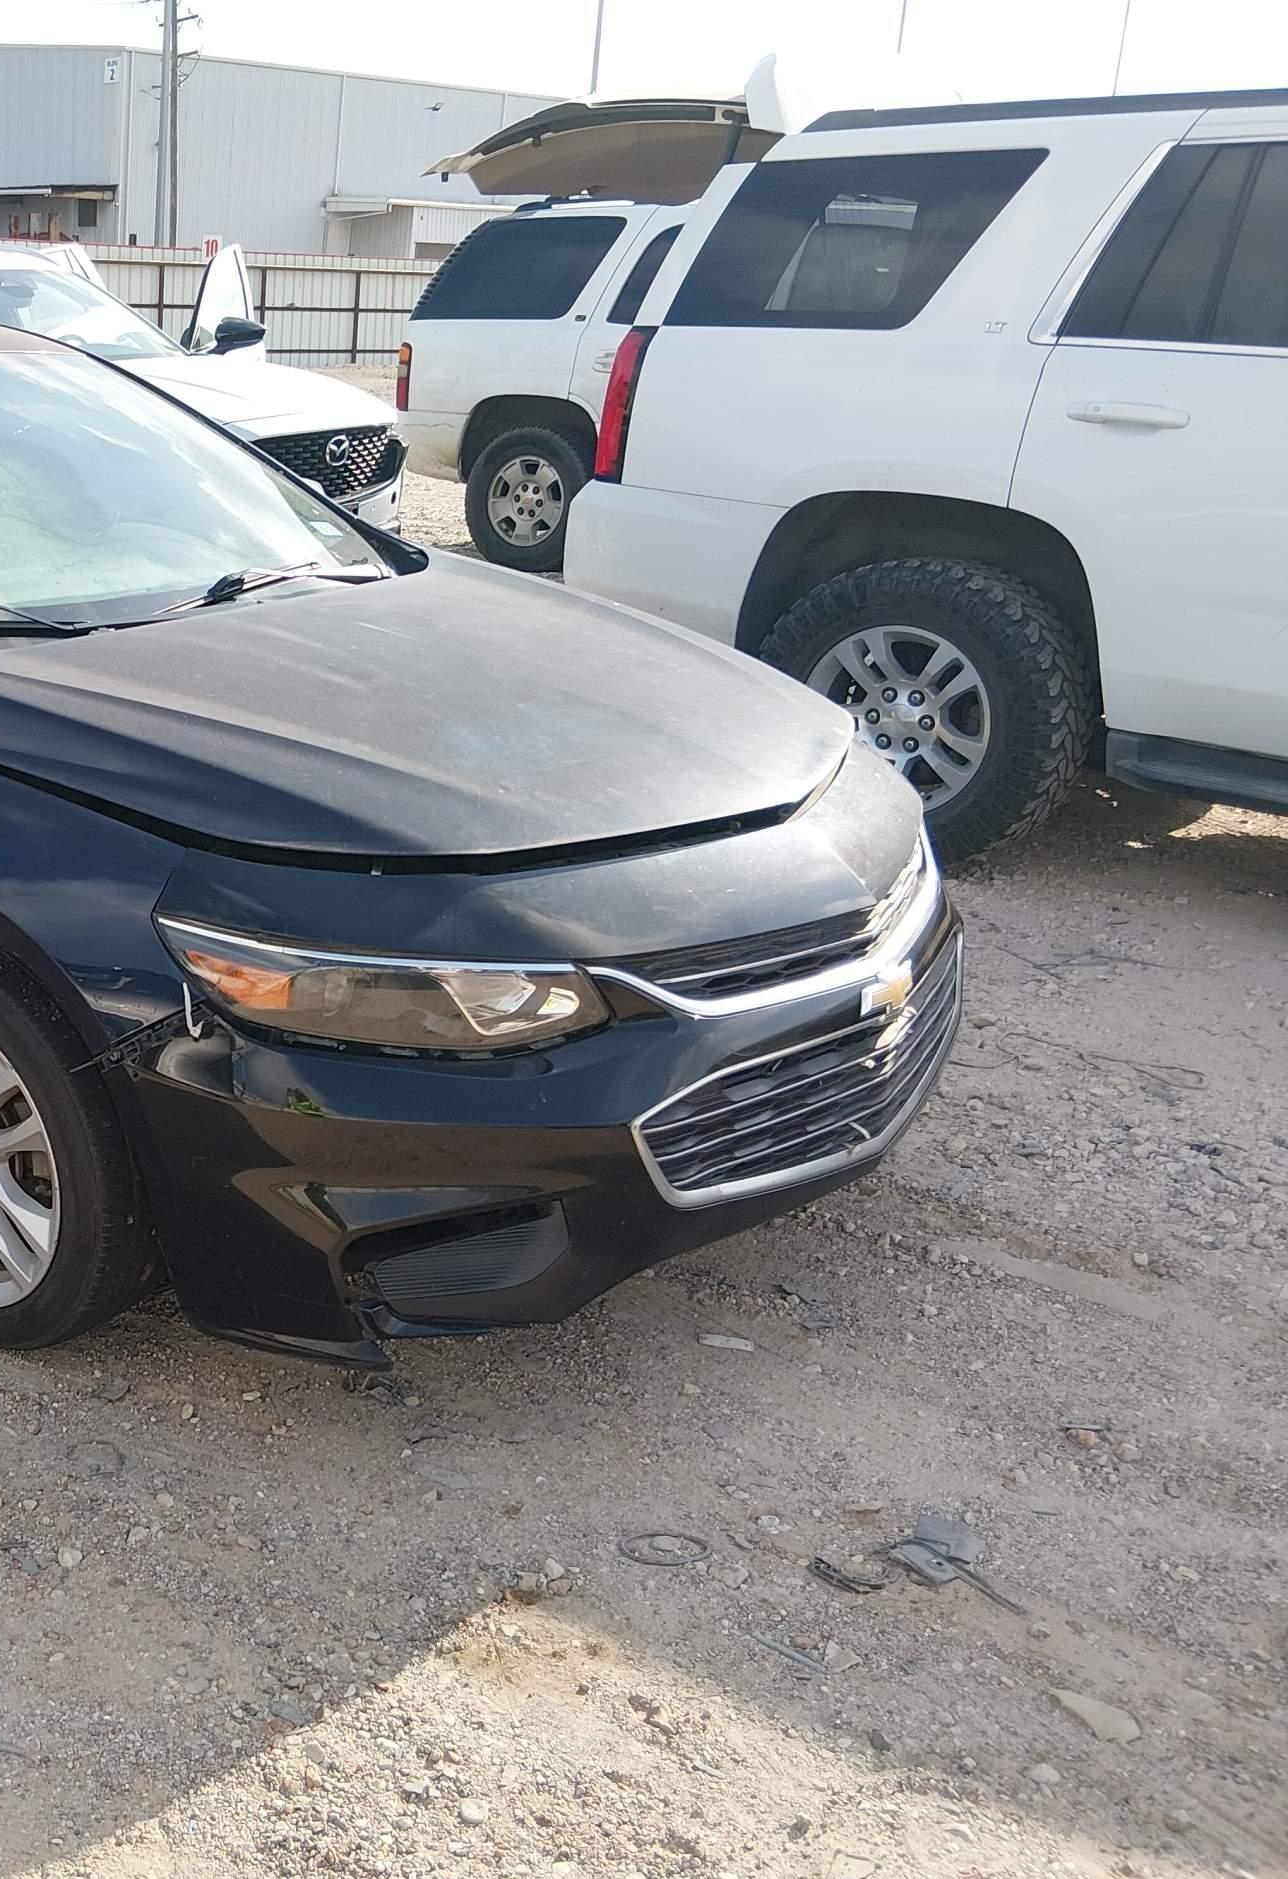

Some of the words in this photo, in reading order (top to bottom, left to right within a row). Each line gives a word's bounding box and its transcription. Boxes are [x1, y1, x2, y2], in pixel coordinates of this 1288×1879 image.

[109, 68, 115, 81] 2
[204, 239, 219, 258] 10
[983, 320, 1009, 335] LT
